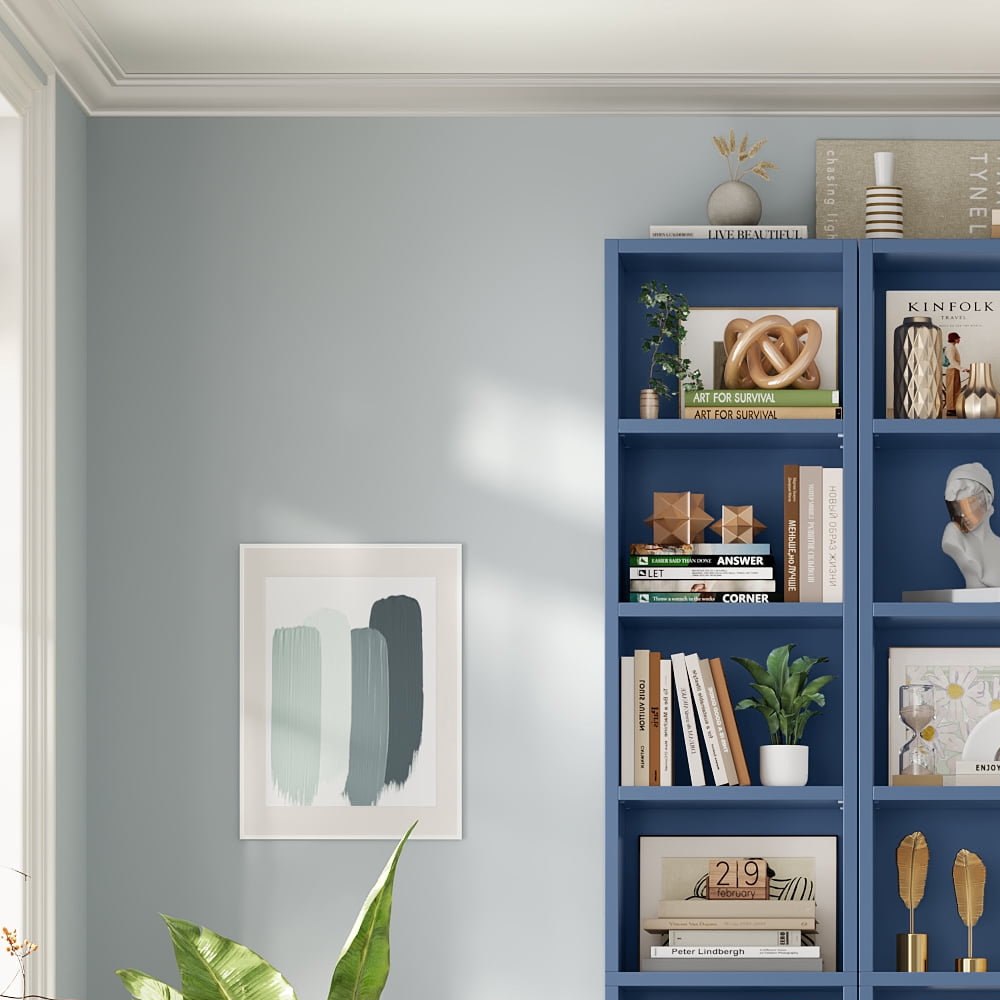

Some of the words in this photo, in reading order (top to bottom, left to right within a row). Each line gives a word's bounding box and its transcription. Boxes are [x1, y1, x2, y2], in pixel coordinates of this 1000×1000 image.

[823, 151, 839, 205] chasing
[708, 229, 735, 239] LIVE
[737, 229, 803, 239] BEAUTIFUL
[908, 301, 995, 312] KINFOLK
[693, 392, 710, 403] ART
[713, 392, 732, 403] FOR
[734, 392, 776, 403] SURVIVAL
[694, 409, 711, 419] ART
[714, 409, 733, 419] FOR
[736, 409, 778, 419] SURVIVAL
[716, 556, 764, 566] ANSWER
[648, 569, 664, 578] LET
[722, 593, 769, 603] CORNER
[975, 764, 1000, 772] ENJOY
[716, 889, 756, 899] february
[671, 948, 694, 956] Peter
[698, 948, 745, 957] Lindbergh
